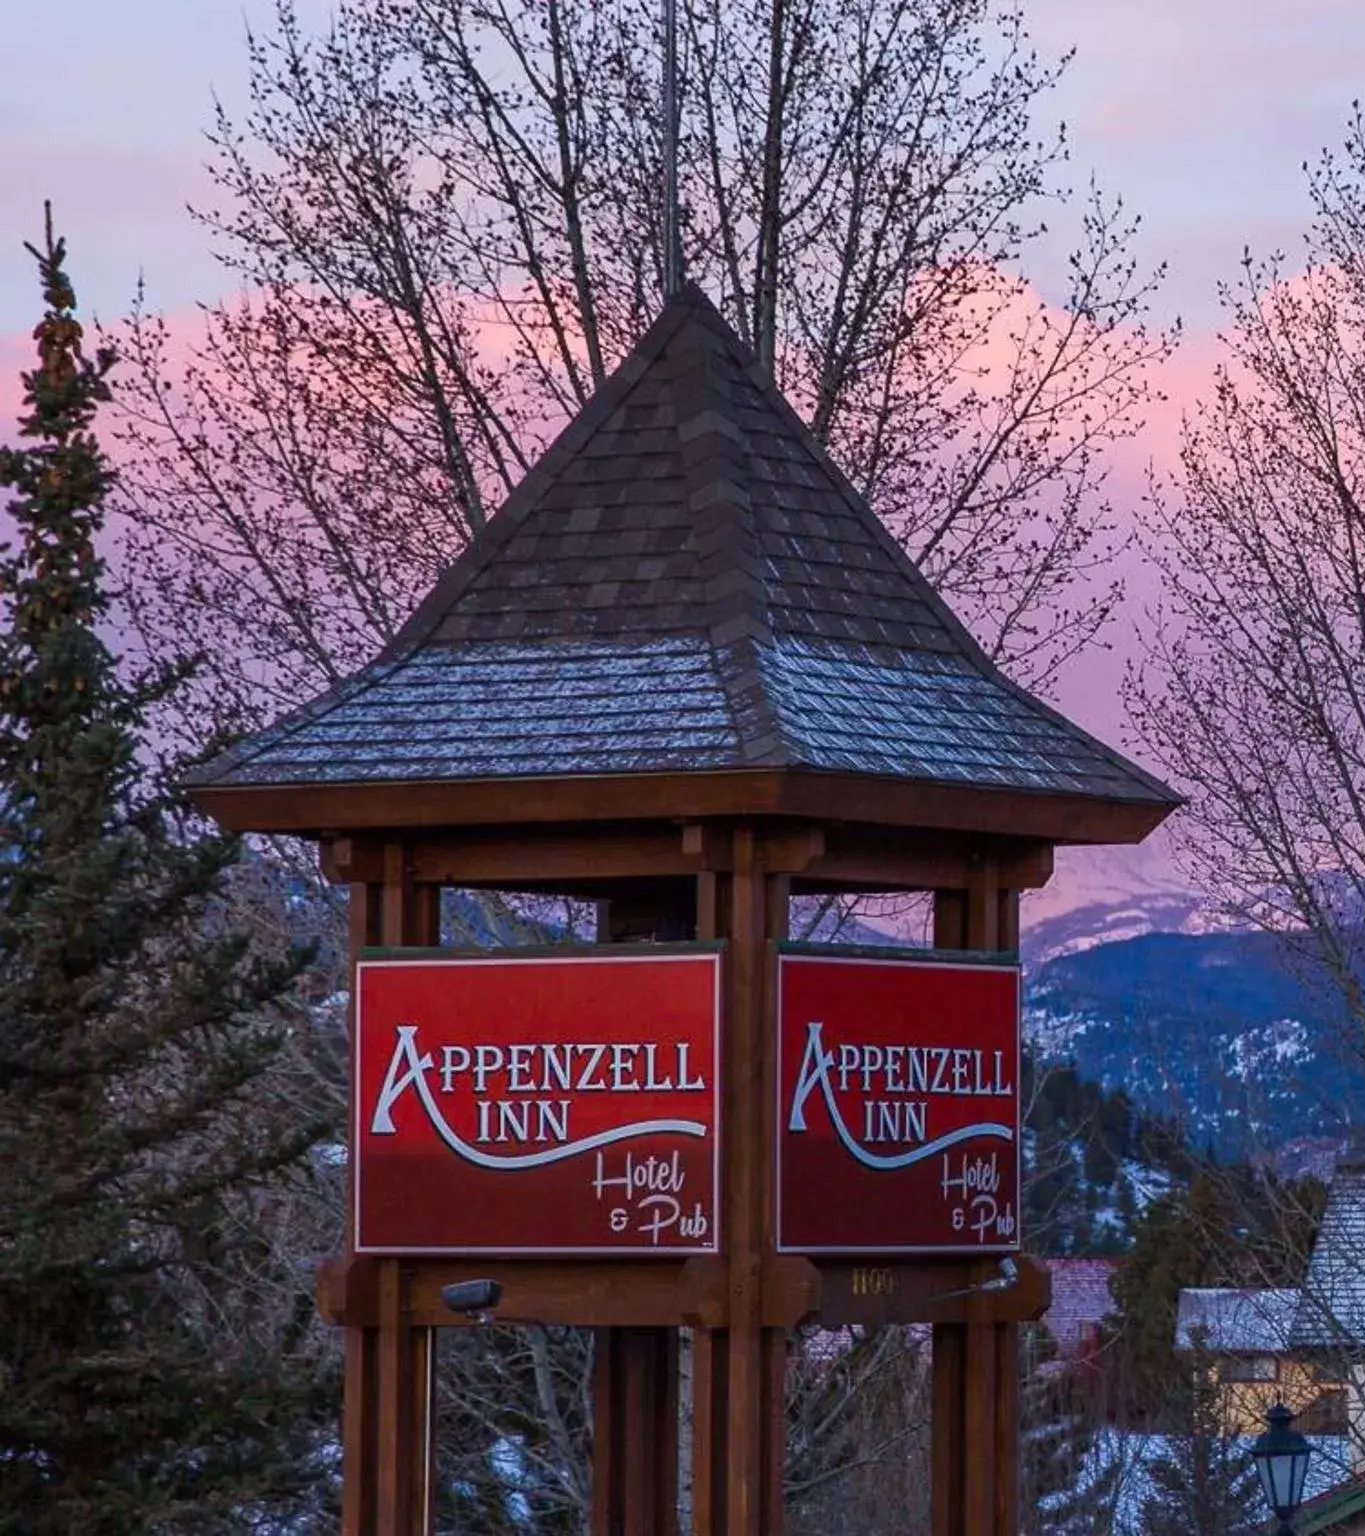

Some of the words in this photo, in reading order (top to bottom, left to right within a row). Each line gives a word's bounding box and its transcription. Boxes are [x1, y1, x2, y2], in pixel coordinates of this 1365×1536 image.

[371, 1025, 706, 1134] APPENZELL
[788, 1021, 1013, 1131] APPENZELL
[476, 1100, 573, 1142] INN
[863, 1101, 928, 1142] INN
[591, 1149, 685, 1200] Hotel
[940, 1151, 1000, 1200] Hotel
[609, 1207, 630, 1231] &
[636, 1194, 707, 1244] Pub
[951, 1207, 965, 1230] &
[971, 1195, 1015, 1242] Pub
